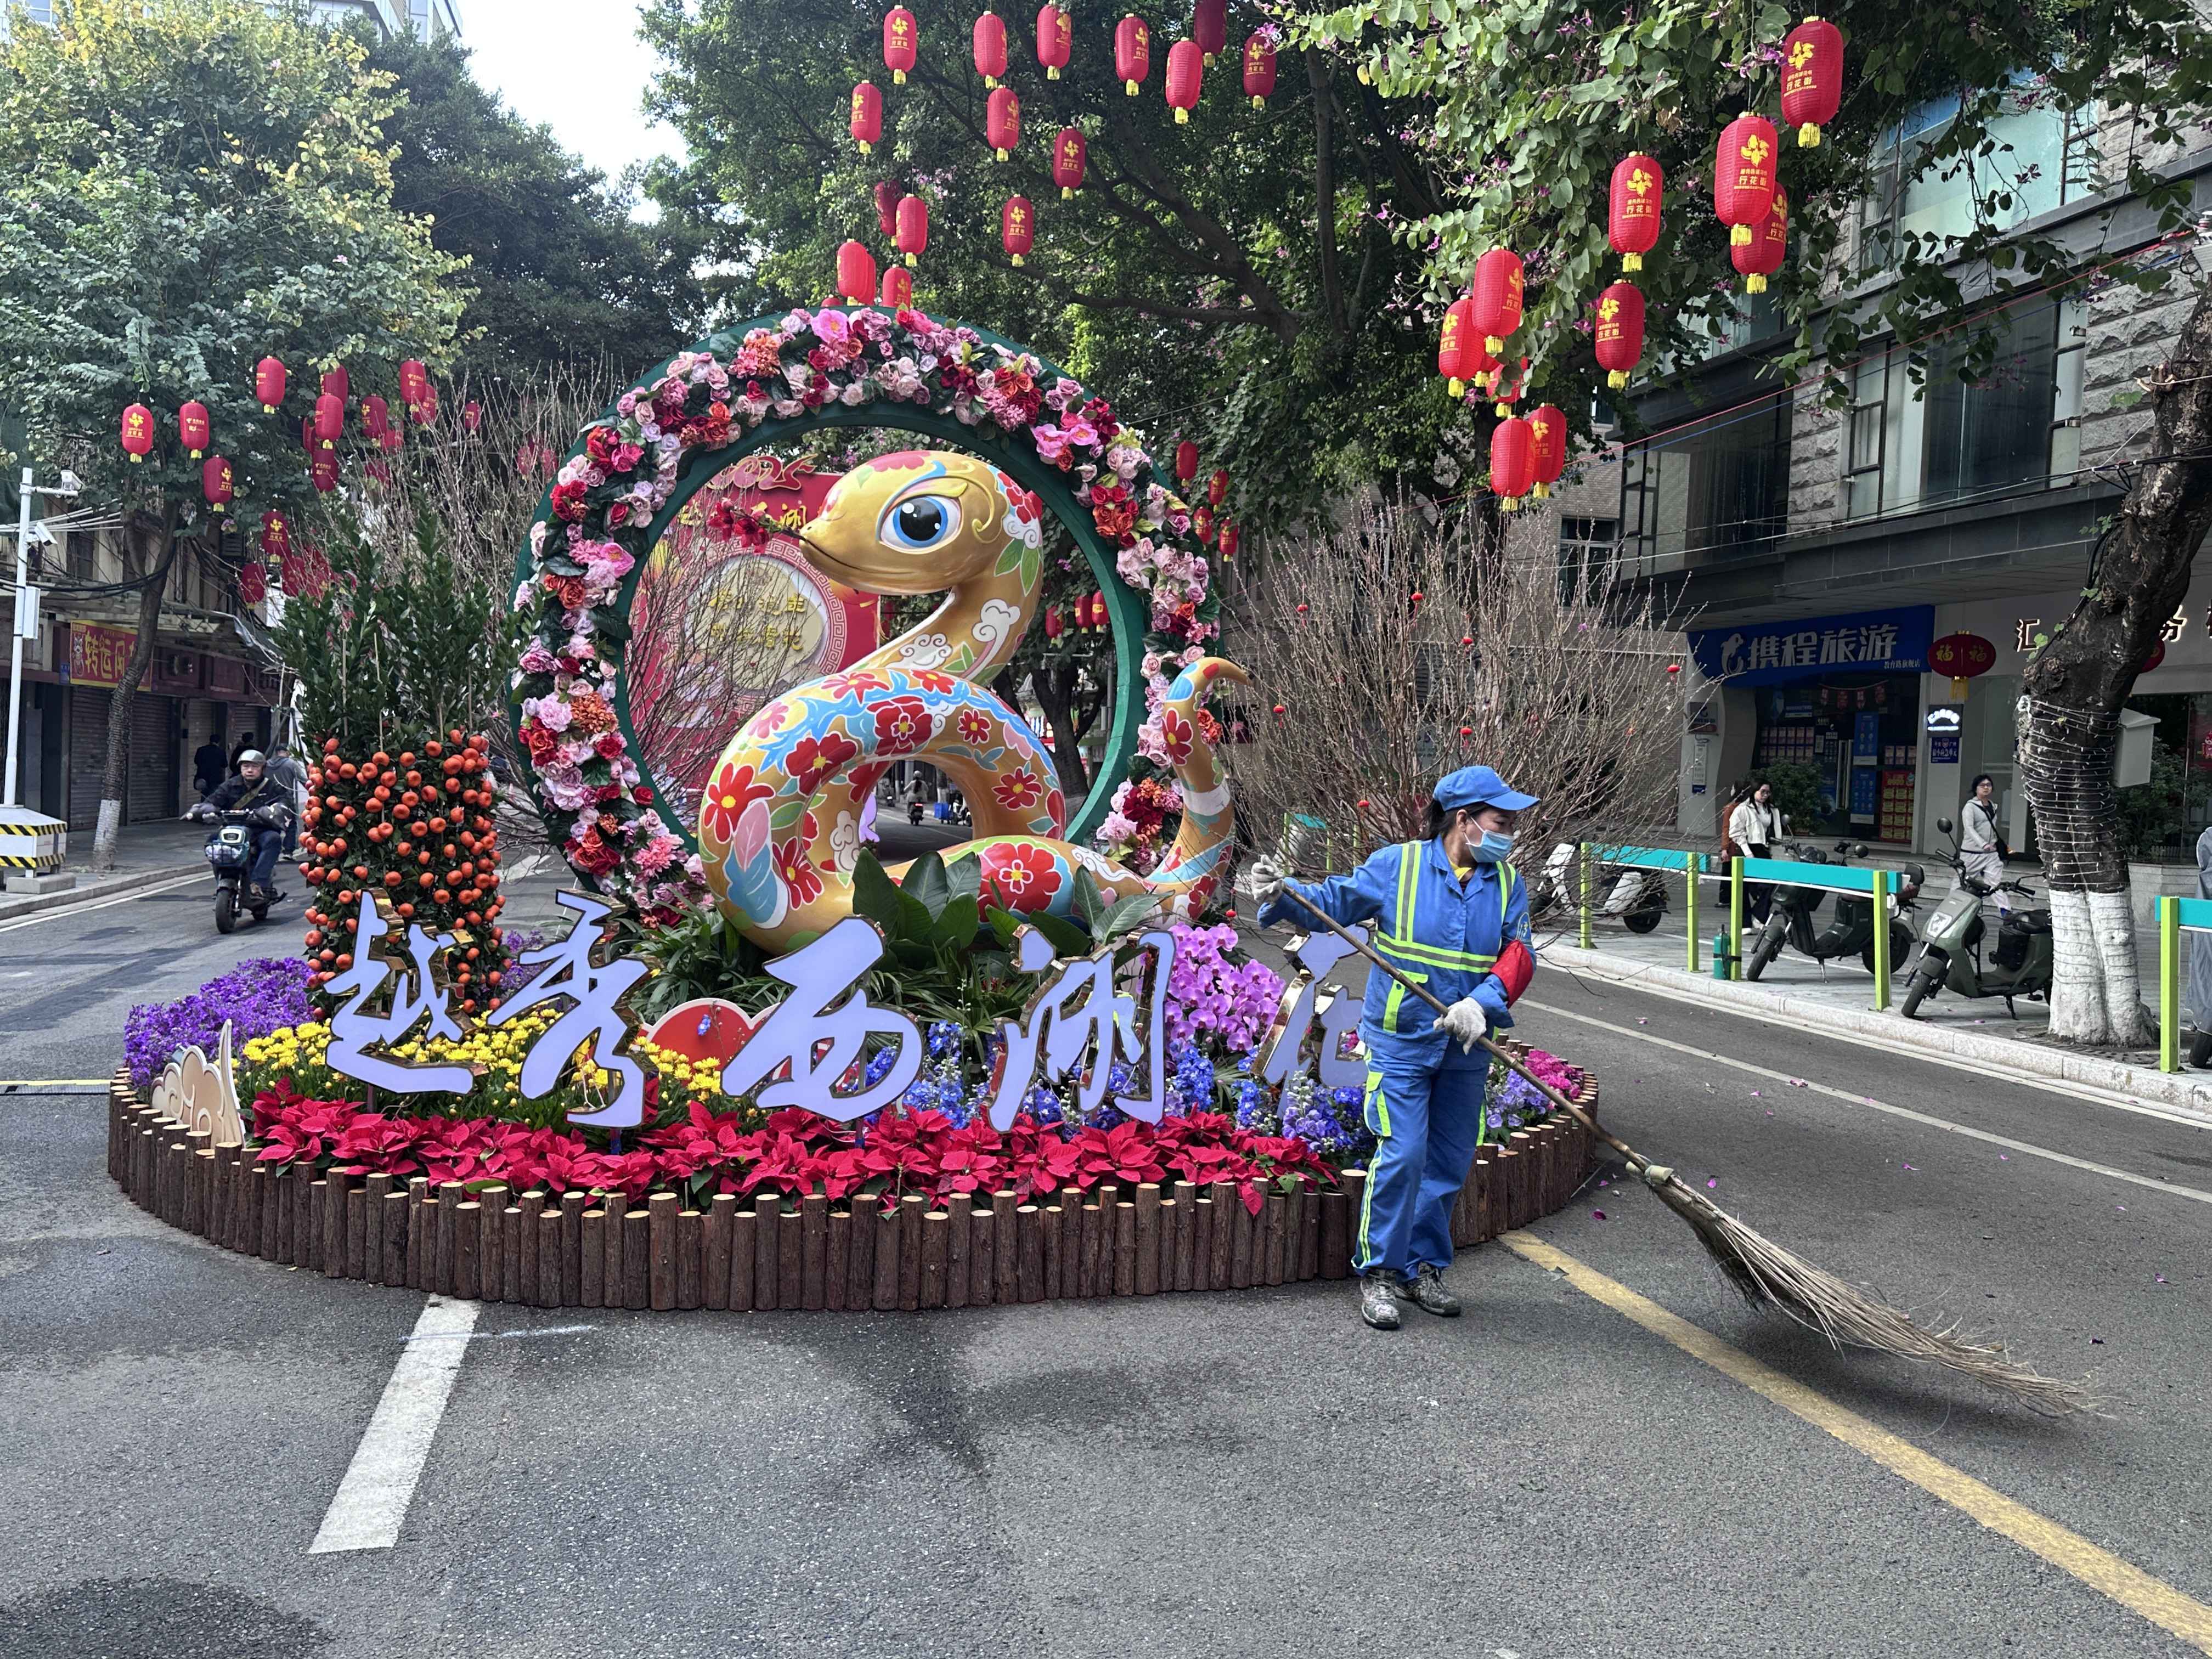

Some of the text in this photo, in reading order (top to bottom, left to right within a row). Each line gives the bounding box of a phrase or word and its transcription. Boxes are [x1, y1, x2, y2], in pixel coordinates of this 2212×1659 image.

[1786, 77, 1813, 91] 行花街
[1739, 176, 1767, 187] 行花街
[1626, 205, 1652, 214] 行花街
[1747, 623, 1899, 670] 携程旅游
[1936, 645, 1954, 662] 福
[1968, 645, 1988, 662] 福
